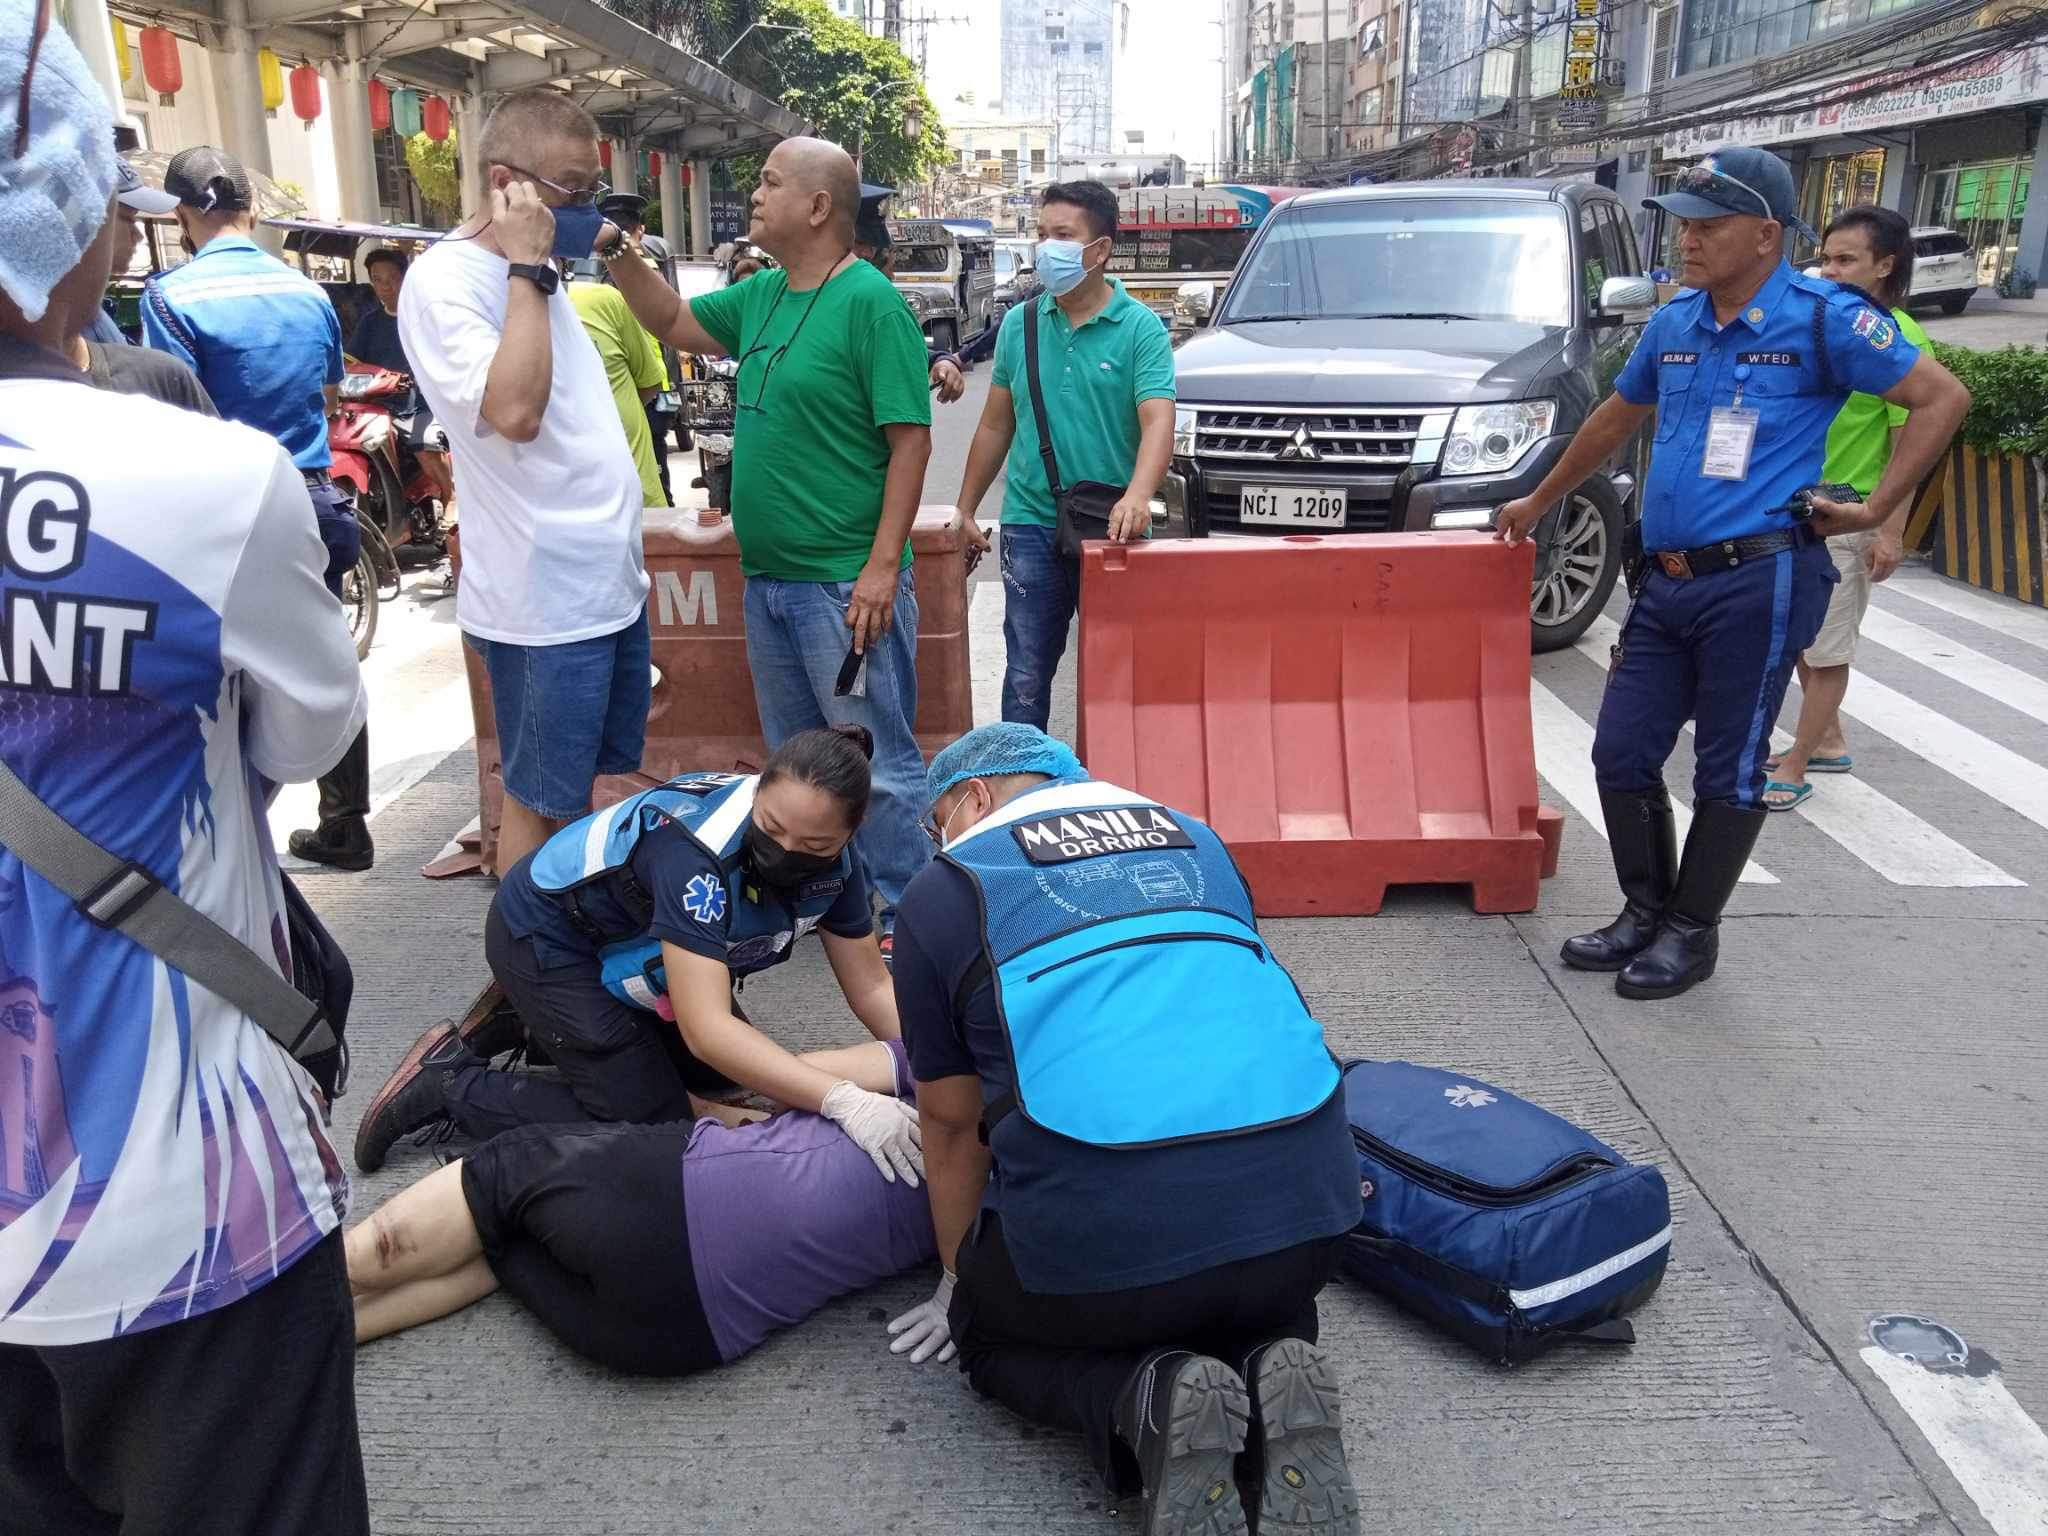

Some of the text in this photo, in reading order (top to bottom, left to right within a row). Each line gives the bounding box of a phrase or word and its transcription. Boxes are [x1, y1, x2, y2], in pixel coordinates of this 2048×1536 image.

[1922, 77, 2003, 105] 09950455888
[1749, 353, 1790, 364] WTED
[1243, 495, 1343, 519] NCI 1209
[0, 475, 80, 574] G
[1020, 808, 1181, 850] MANILA
[1058, 832, 1168, 857] DRRMO
